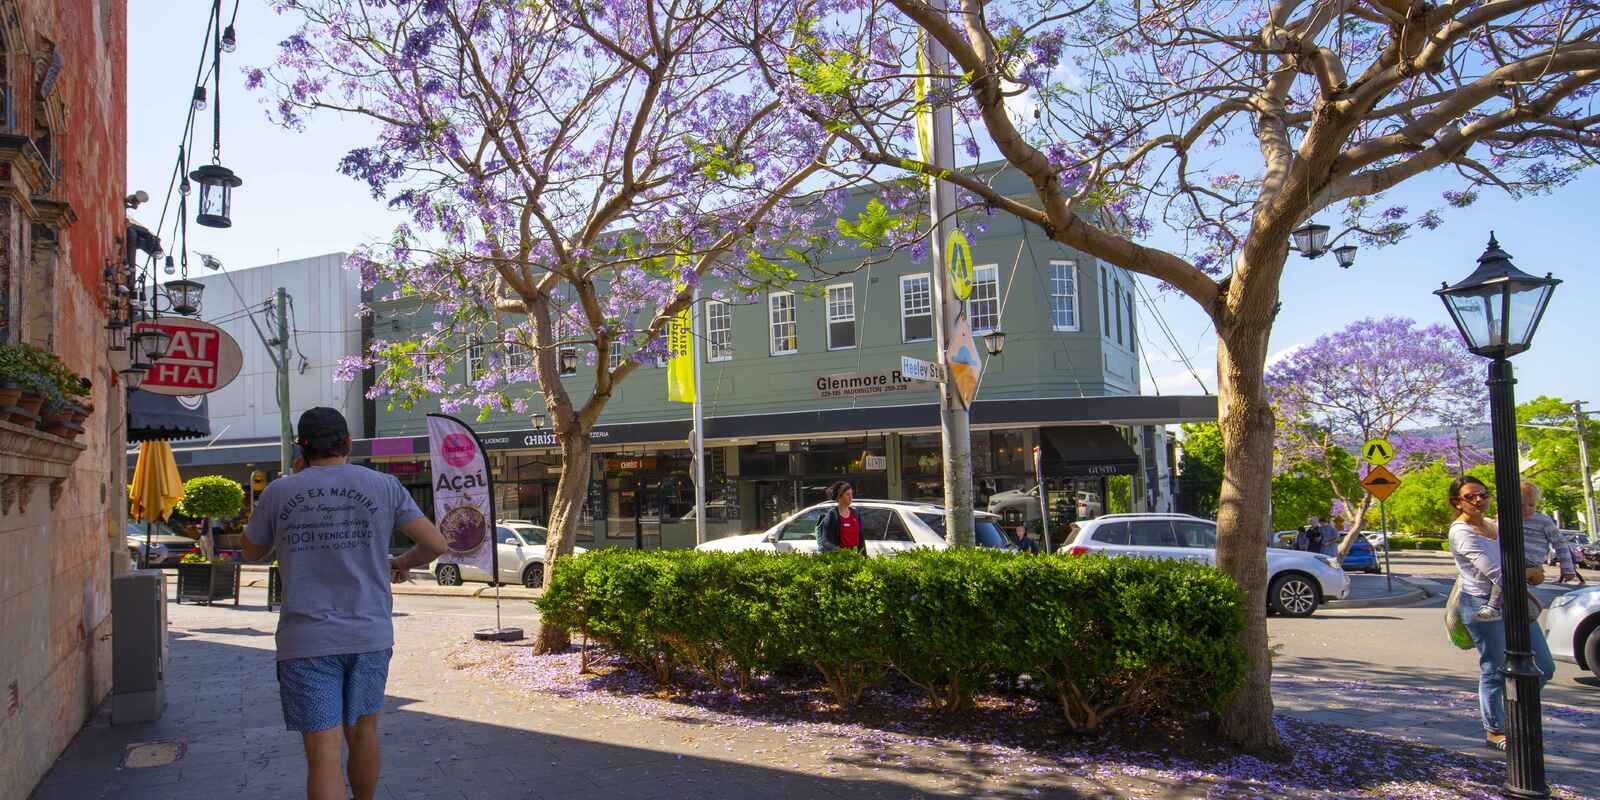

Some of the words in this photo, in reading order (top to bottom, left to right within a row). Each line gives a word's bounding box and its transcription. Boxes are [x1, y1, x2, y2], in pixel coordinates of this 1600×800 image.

[903, 358, 928, 379] Heeley
[929, 363, 938, 378] St
[816, 375, 887, 390] Glenmore
[524, 433, 560, 446] CHRiST
[436, 469, 486, 492] Açaí
[279, 493, 305, 520] DEUS
[307, 487, 325, 498] EX
[330, 487, 378, 515] MACHINA
[318, 530, 350, 540] VENICE
